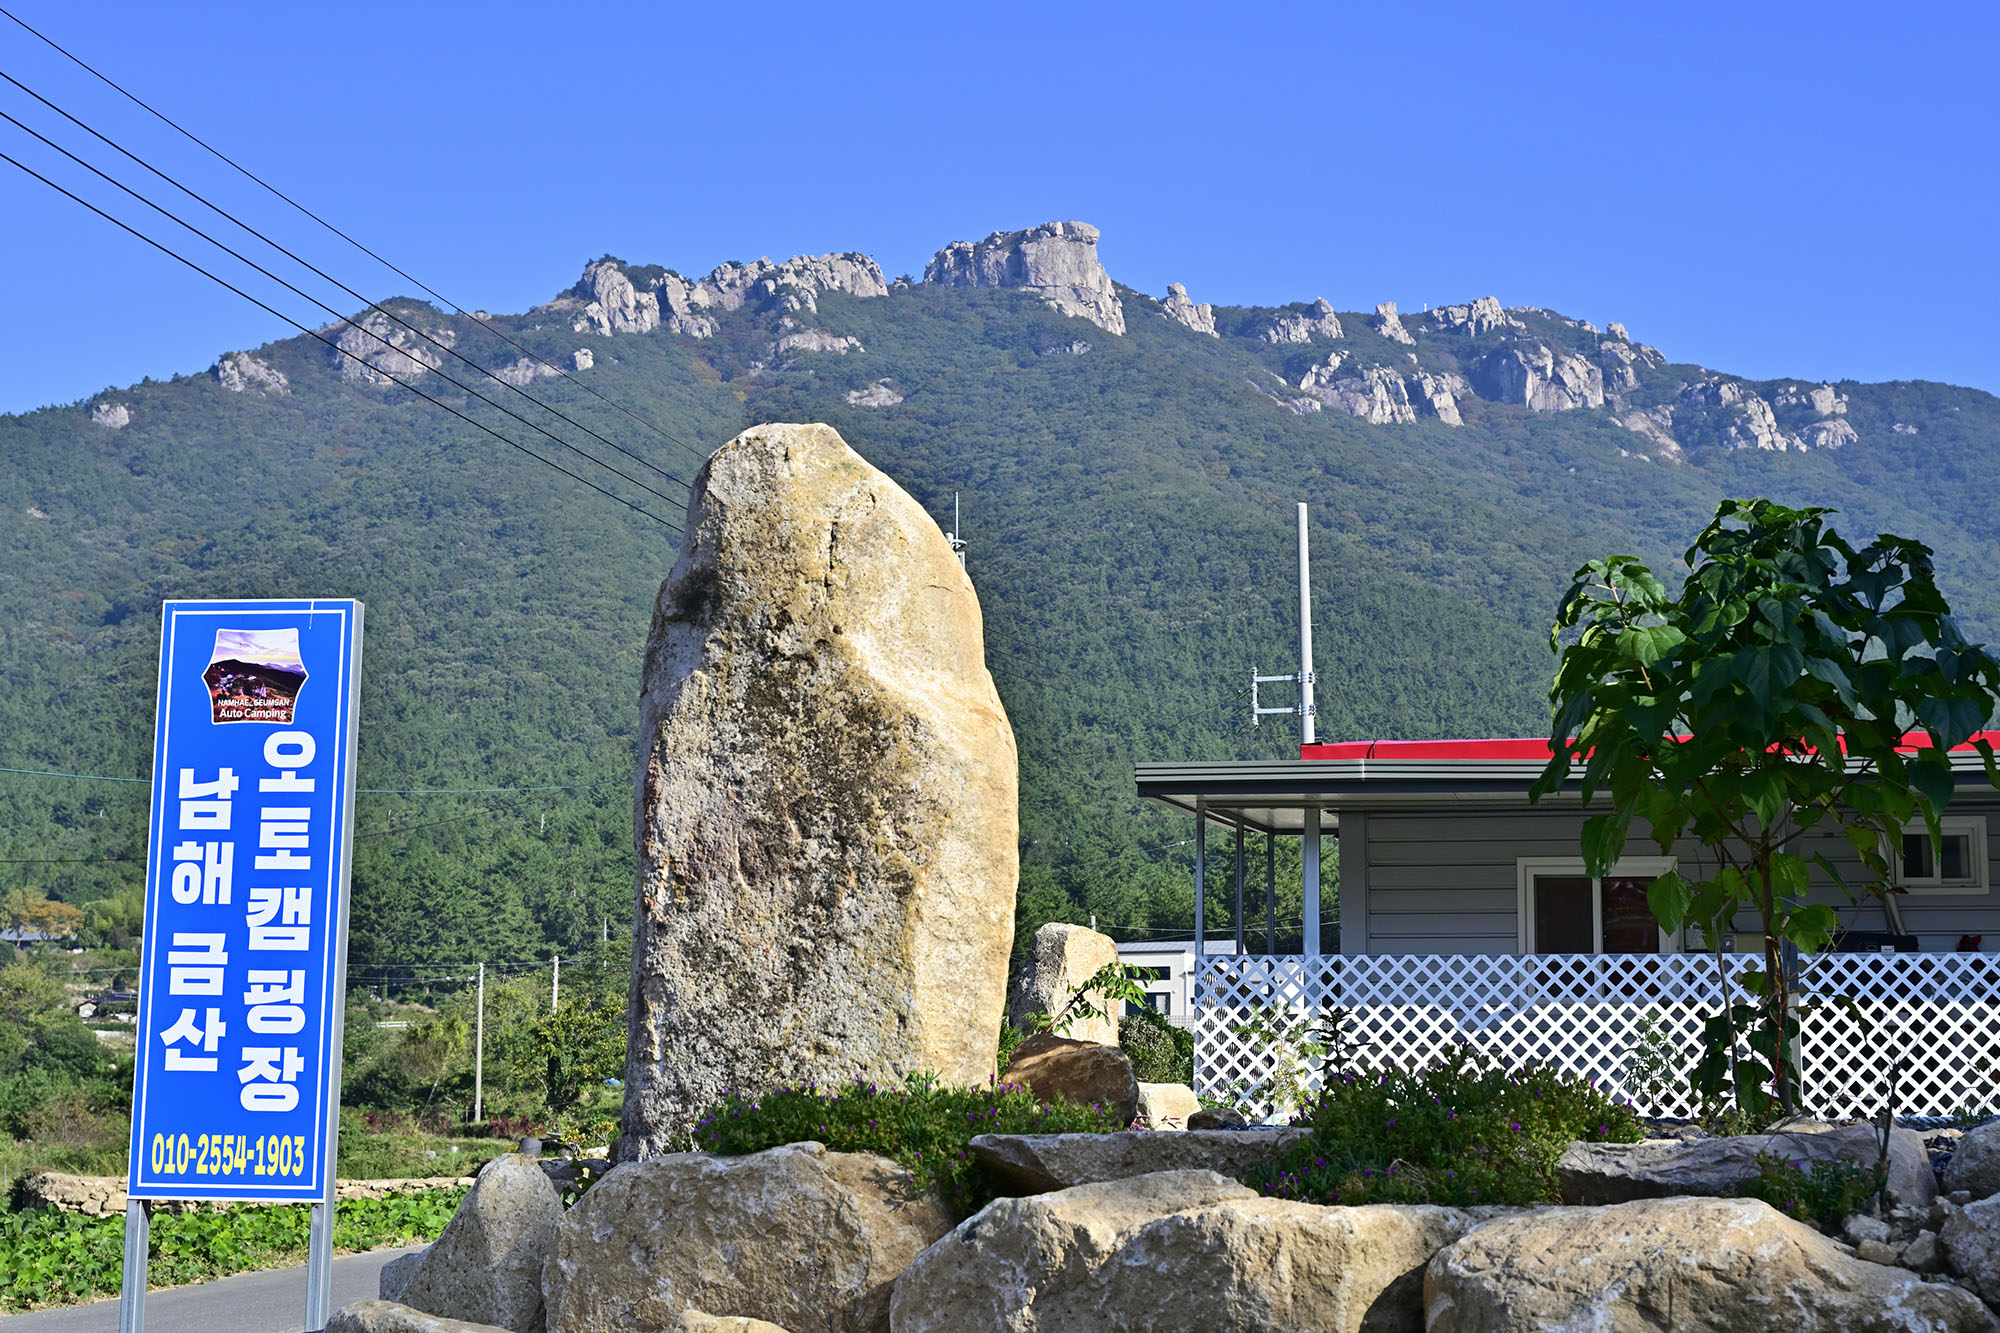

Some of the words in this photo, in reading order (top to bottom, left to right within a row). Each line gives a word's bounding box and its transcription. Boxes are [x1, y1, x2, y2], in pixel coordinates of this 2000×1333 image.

[219, 708, 243, 718] Auto
[244, 707, 287, 720] Camping
[172, 768, 239, 904] 남해
[237, 731, 315, 1112] 오토캠핑장
[160, 933, 228, 1071] 금산
[152, 1132, 305, 1176] 010-2554-1903
